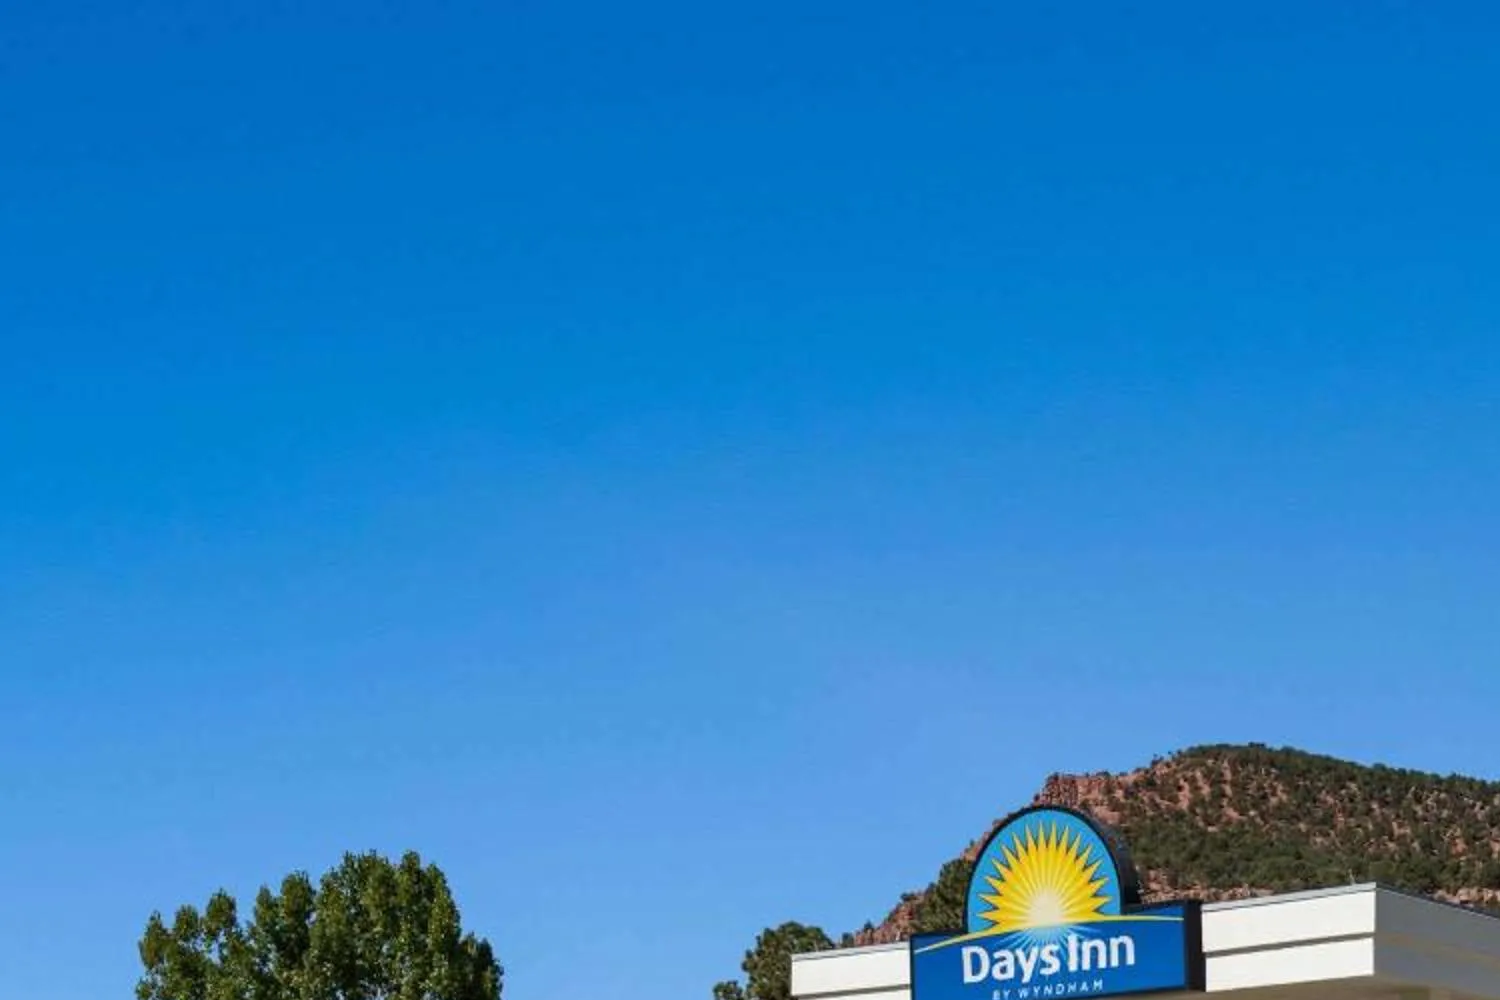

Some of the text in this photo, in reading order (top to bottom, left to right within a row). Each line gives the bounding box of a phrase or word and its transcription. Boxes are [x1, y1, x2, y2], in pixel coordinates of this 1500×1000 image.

[961, 933, 1136, 984] Days Inn
[992, 979, 1103, 1000] BY WYNDHAM
